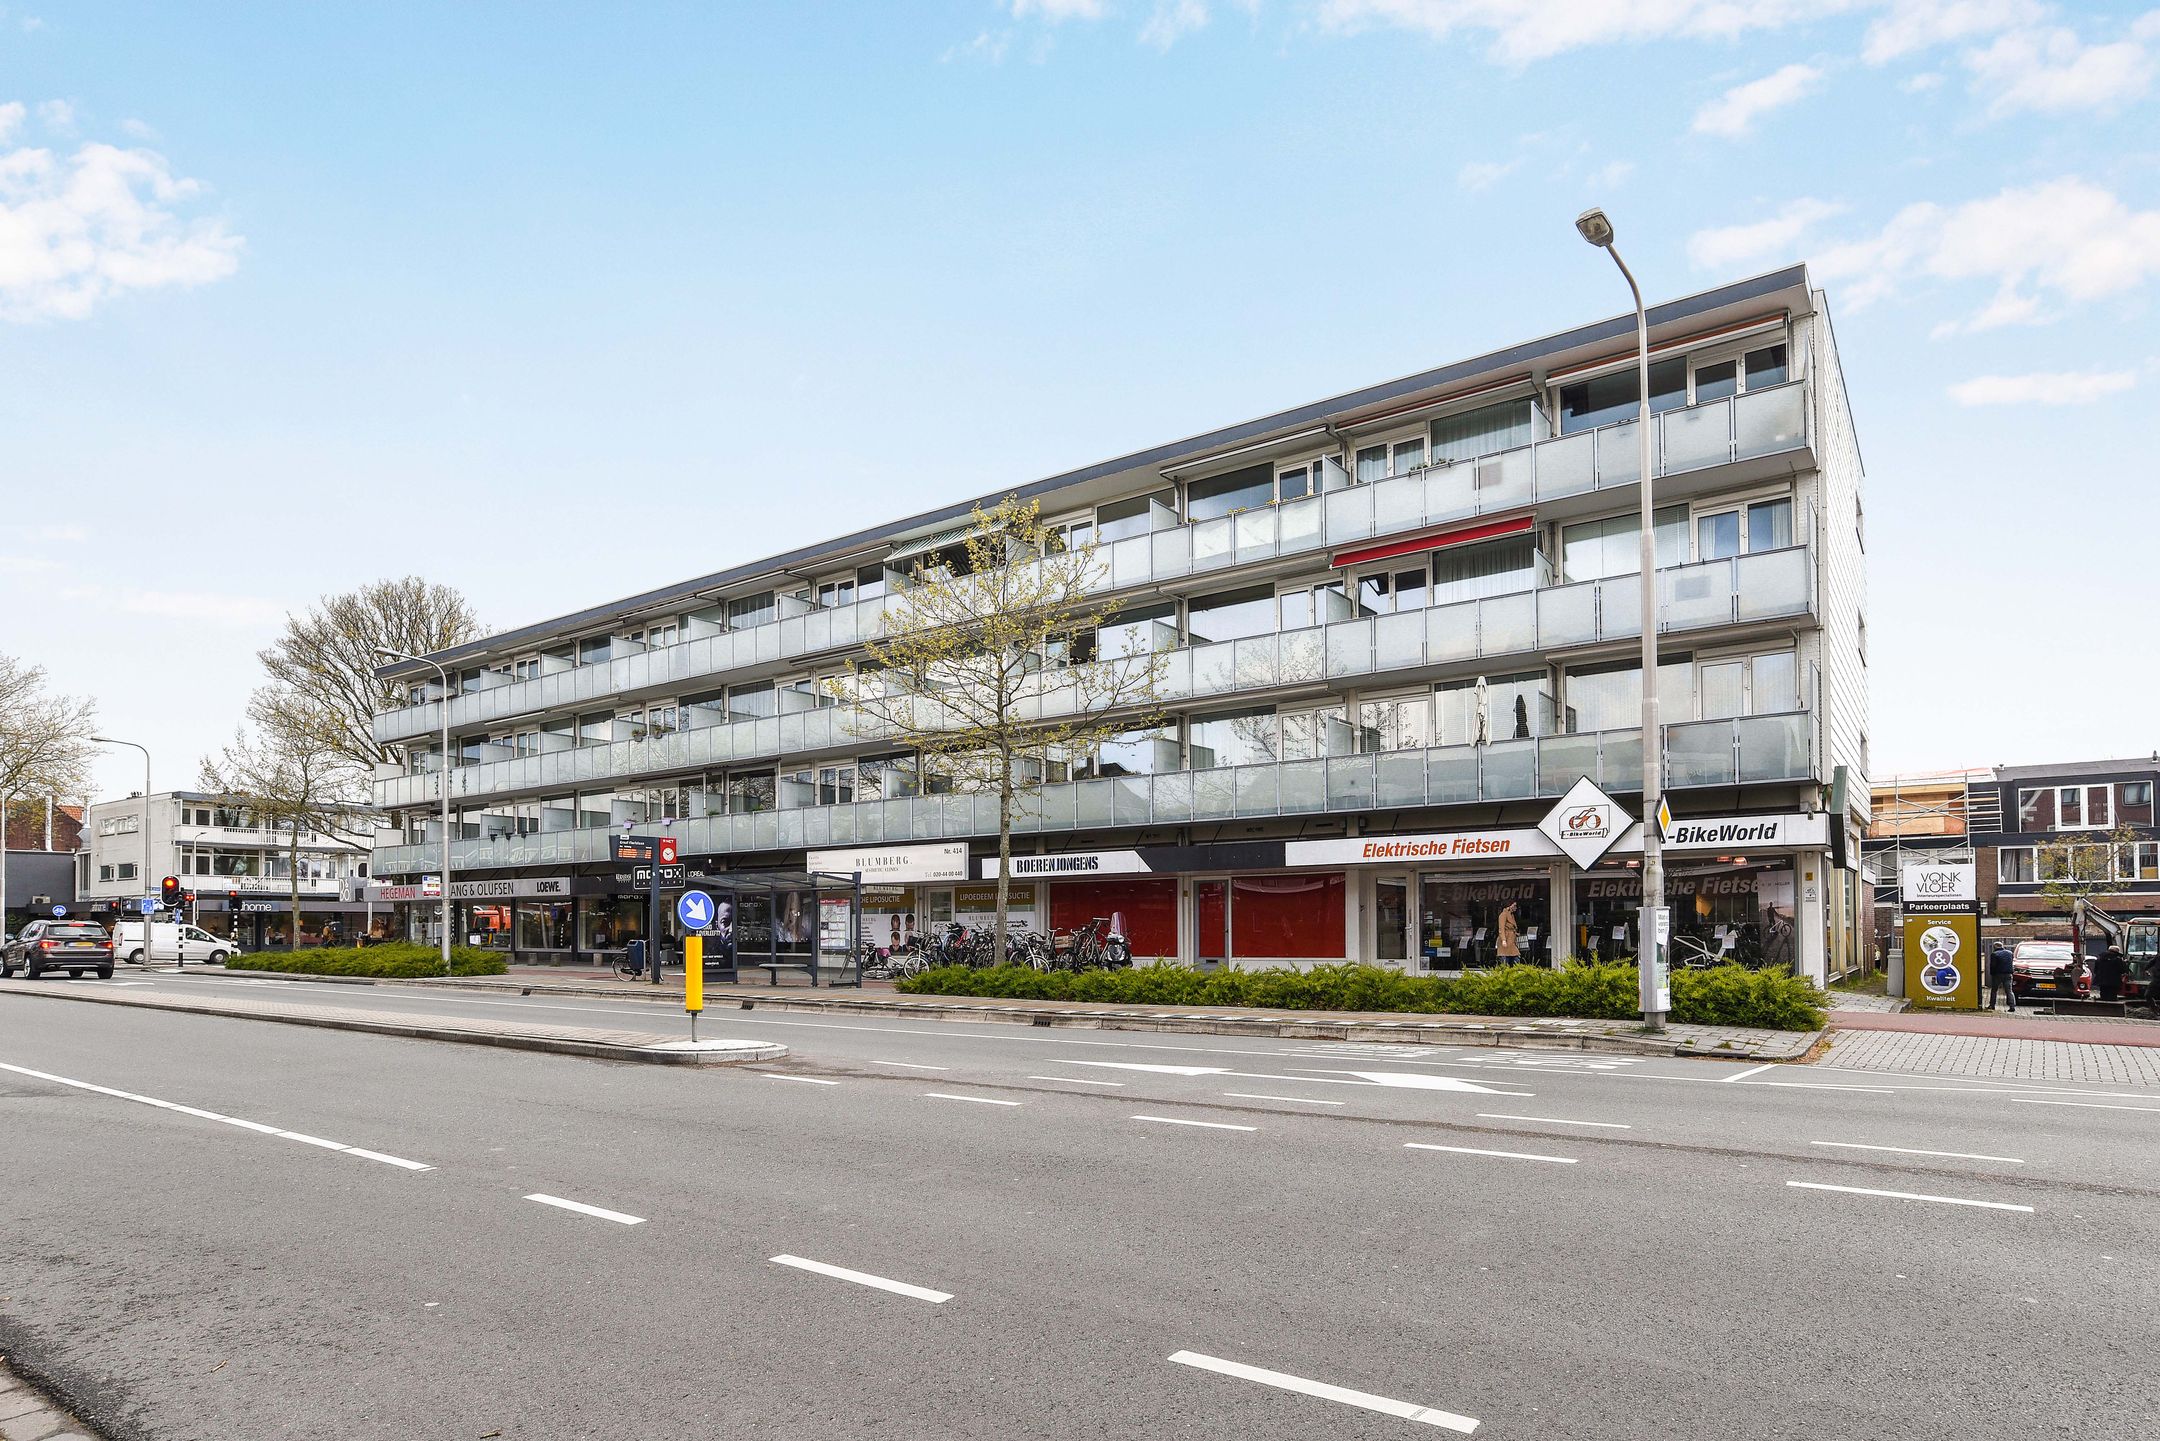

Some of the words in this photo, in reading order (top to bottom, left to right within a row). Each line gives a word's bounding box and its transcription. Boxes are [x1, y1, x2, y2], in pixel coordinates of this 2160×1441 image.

[1363, 839, 1447, 858] Elektrische
[1451, 838, 1510, 855] Fietsen
[1921, 871, 1961, 882] VONK
[381, 887, 416, 899] HEGEMAN
[450, 884, 467, 896] ANG
[469, 887, 475, 895] &
[477, 882, 514, 895] OLUFSEN
[1916, 882, 1955, 893] VLOER
[1909, 903, 1970, 911] Parkeerplaats
[1934, 951, 1947, 964] &
